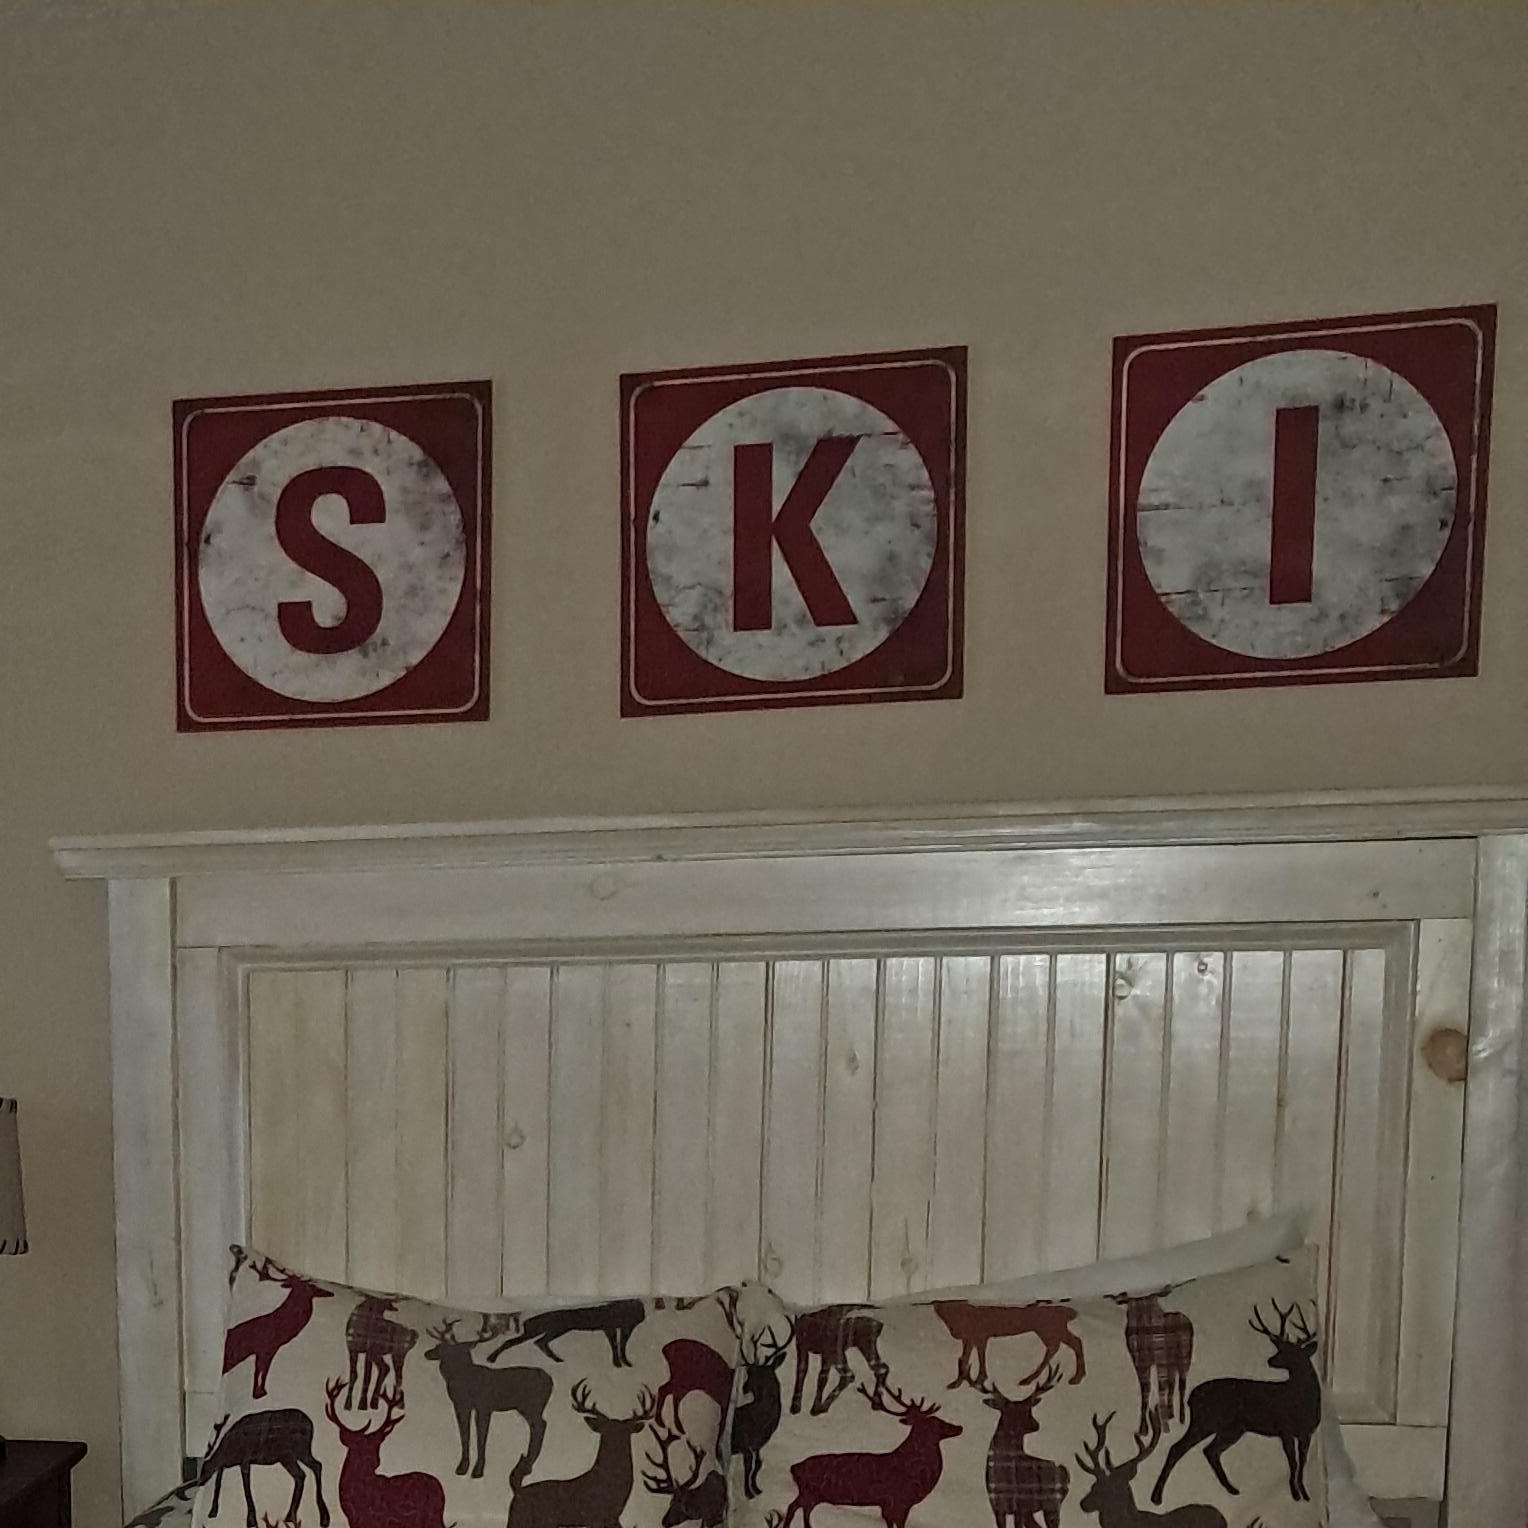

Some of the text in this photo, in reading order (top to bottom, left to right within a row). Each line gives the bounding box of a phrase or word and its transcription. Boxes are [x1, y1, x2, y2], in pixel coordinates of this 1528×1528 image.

[275, 465, 386, 654] S
[732, 434, 864, 632] K
[1269, 405, 1320, 605] I
